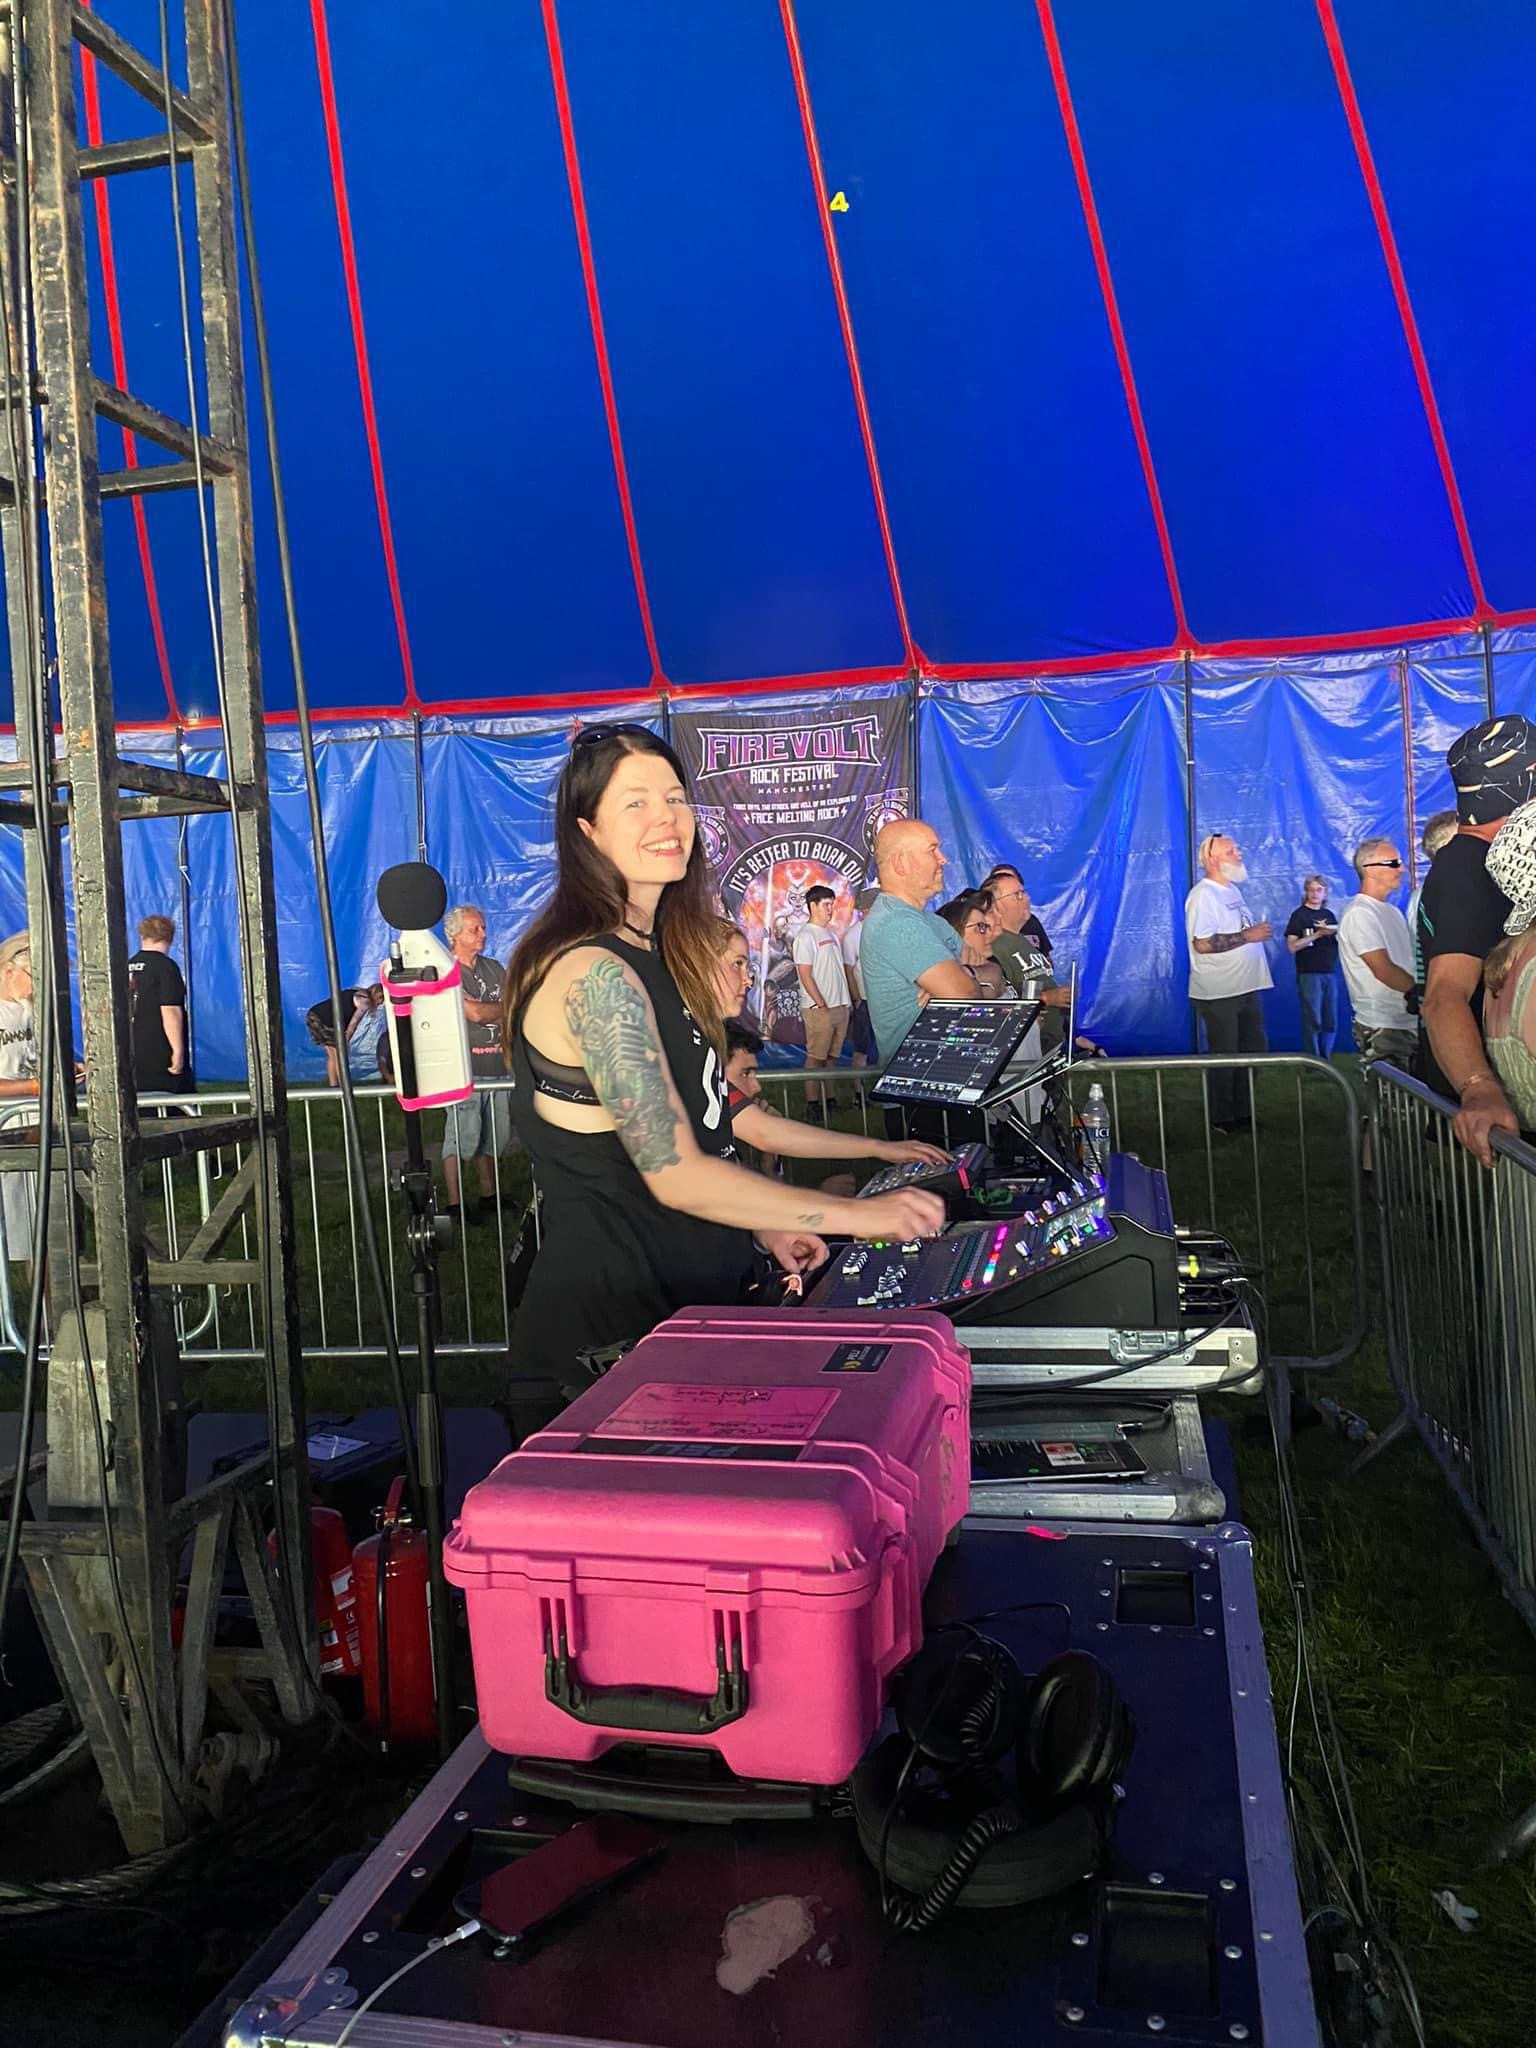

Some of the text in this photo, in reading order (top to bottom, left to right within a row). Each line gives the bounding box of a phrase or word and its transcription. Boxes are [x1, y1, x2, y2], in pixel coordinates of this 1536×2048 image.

[830, 191, 849, 212] 4
[706, 721, 873, 771] FIREVOLT
[750, 763, 839, 784] ROCK FESTIVAL
[758, 784, 832, 794] MANCHESTER
[752, 806, 840, 824] FACE MELTING ROCK
[729, 867, 752, 893] IT'S
[746, 842, 790, 874] BETTER
[792, 841, 809, 859] TO
[811, 843, 847, 869] BURN
